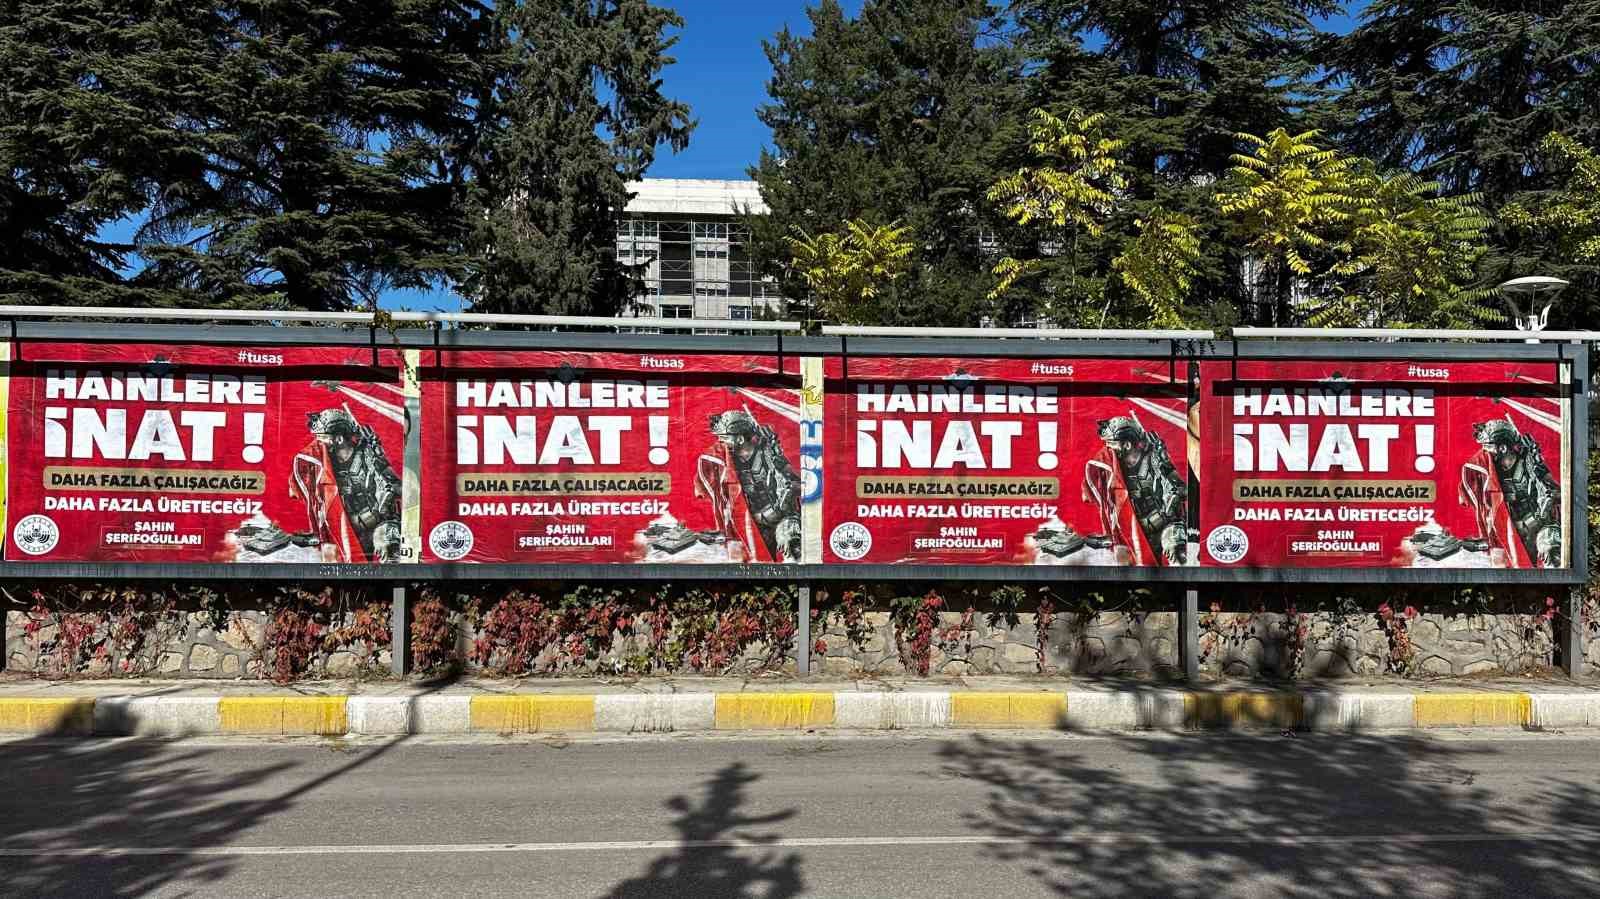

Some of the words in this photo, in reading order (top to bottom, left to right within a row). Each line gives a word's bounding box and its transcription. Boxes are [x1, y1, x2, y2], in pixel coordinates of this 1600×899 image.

[238, 351, 283, 365] #tusaş
[640, 354, 684, 368] #tusaş
[1031, 362, 1074, 376] #tusaş
[1408, 366, 1449, 379] #tusaş
[51, 473, 98, 487] DAHA
[100, 475, 151, 489] FAZLA
[154, 473, 257, 491] ÇALIŞACAĞIZ
[464, 478, 509, 492] DAHA
[512, 479, 561, 492] FAZLA
[563, 477, 664, 494] ÇALIŞACAĞIZ
[863, 481, 907, 495] DAHA
[909, 482, 954, 496] FAZLA
[957, 480, 1053, 497] ÇALIŞACAĞIZ
[1240, 485, 1282, 498] DAHA
[1285, 485, 1331, 499] FAZLA
[1334, 483, 1429, 501] ÇALIŞACAĞIZ
[45, 496, 95, 511] DAHA
[99, 497, 154, 513] FAZLA
[158, 496, 263, 514] ÜRETECEĞİZ
[459, 502, 508, 516] DAHA
[511, 502, 564, 516] FAZLA
[567, 501, 670, 516] ÜRETECEĞİZ
[857, 504, 904, 518] DAHA
[908, 504, 957, 518] FAZLA
[961, 502, 1058, 519] ÜRETECEĞİZ
[1235, 507, 1281, 521] DAHA
[1285, 507, 1334, 521] FAZLA
[1338, 506, 1434, 522] ÜRETECEĞİZ
